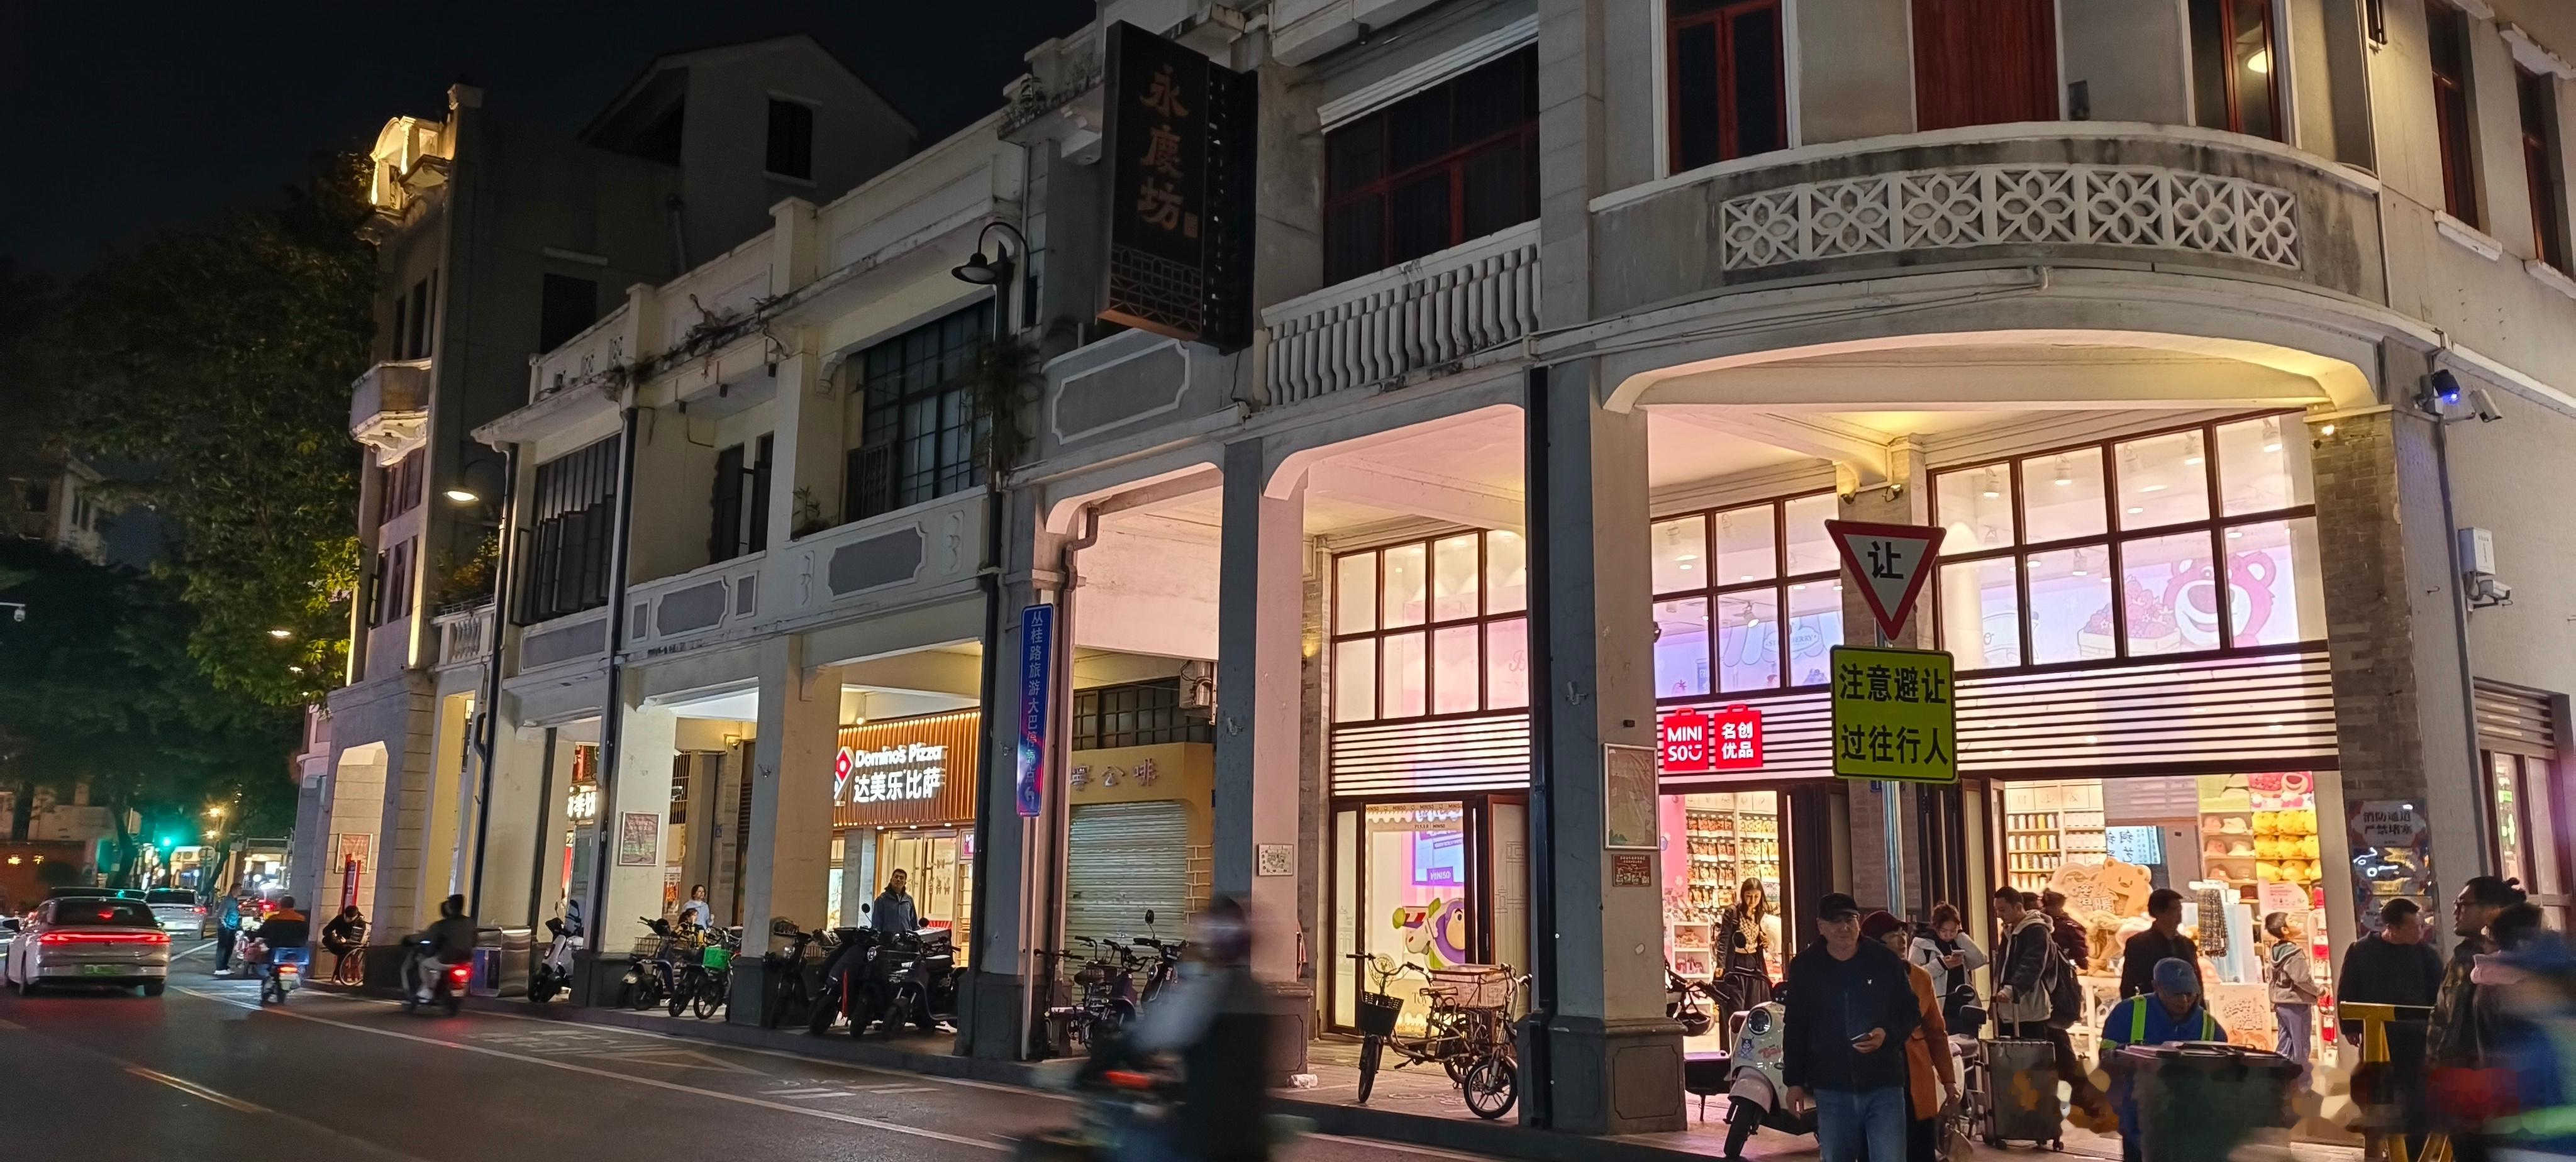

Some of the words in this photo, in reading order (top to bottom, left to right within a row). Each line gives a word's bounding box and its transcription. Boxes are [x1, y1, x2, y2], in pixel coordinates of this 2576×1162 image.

[1867, 541, 1904, 580] 让
[1838, 663, 1947, 705] 注意避让
[1667, 726, 1702, 742] MINI
[1721, 721, 1753, 739] 名创
[855, 745, 907, 768] Domino's
[908, 742, 944, 763] Pizza
[1721, 741, 1754, 760] 优品
[1841, 724, 1948, 766] 过往行人
